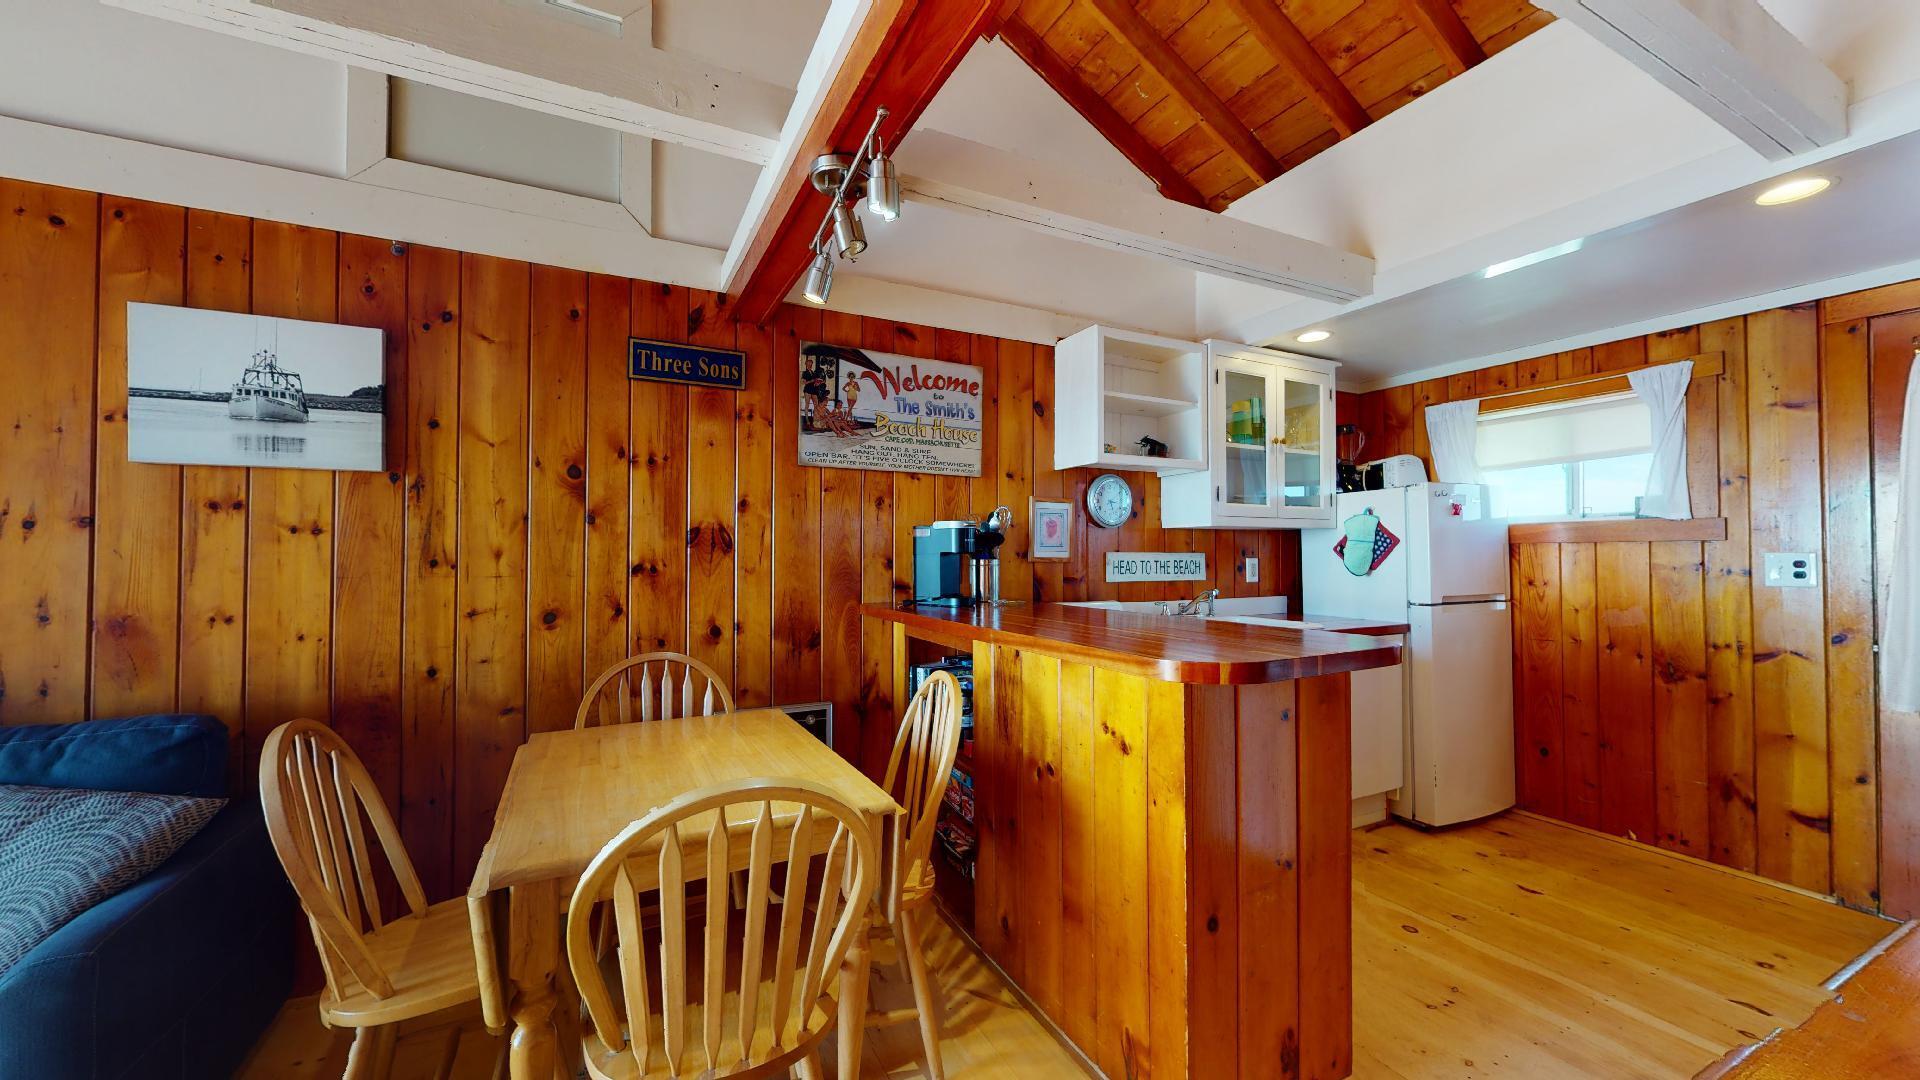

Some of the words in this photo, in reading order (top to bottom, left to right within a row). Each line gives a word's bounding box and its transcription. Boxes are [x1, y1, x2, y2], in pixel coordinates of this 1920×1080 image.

[637, 349, 692, 374] Three
[698, 356, 739, 379] Sons
[860, 364, 980, 400] Welcome
[894, 396, 920, 415] The
[925, 400, 975, 420] Smith's
[933, 392, 945, 401] to
[870, 411, 926, 438] Beach
[932, 416, 977, 444] House
[891, 457, 924, 465] O'CLOCK
[1112, 560, 1138, 575] HEAD
[1140, 560, 1152, 575] TO
[1154, 560, 1171, 575] THE
[1173, 559, 1201, 575] BEACH
